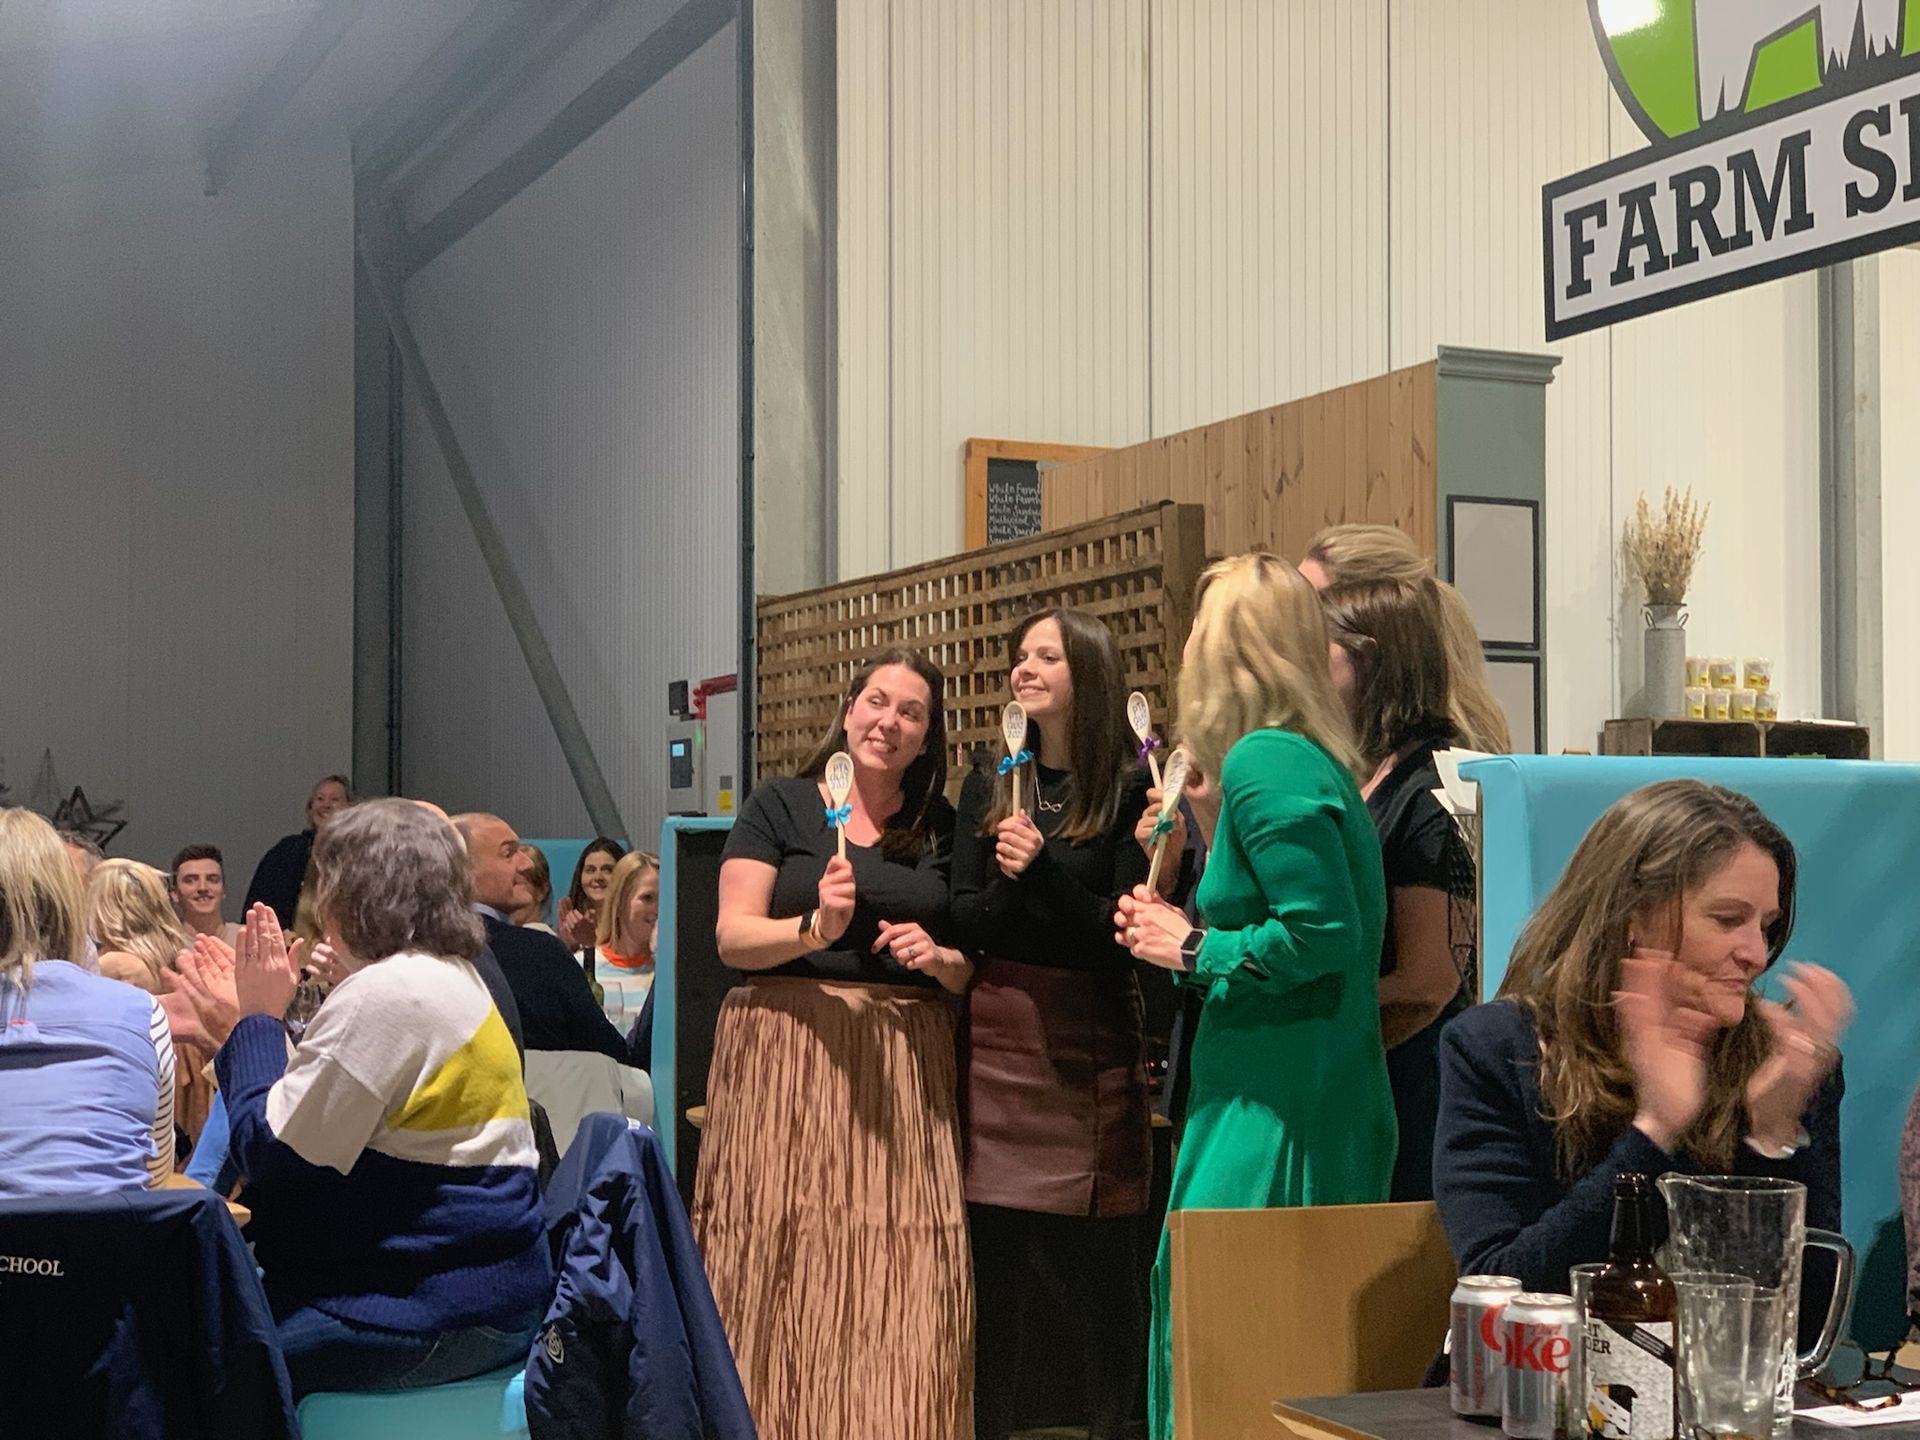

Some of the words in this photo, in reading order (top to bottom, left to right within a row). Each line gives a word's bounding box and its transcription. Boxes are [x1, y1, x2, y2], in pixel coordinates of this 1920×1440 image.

[1564, 129, 1814, 300] FARM
[1842, 93, 1920, 218] S
[0, 1255, 65, 1277] CHOOL
